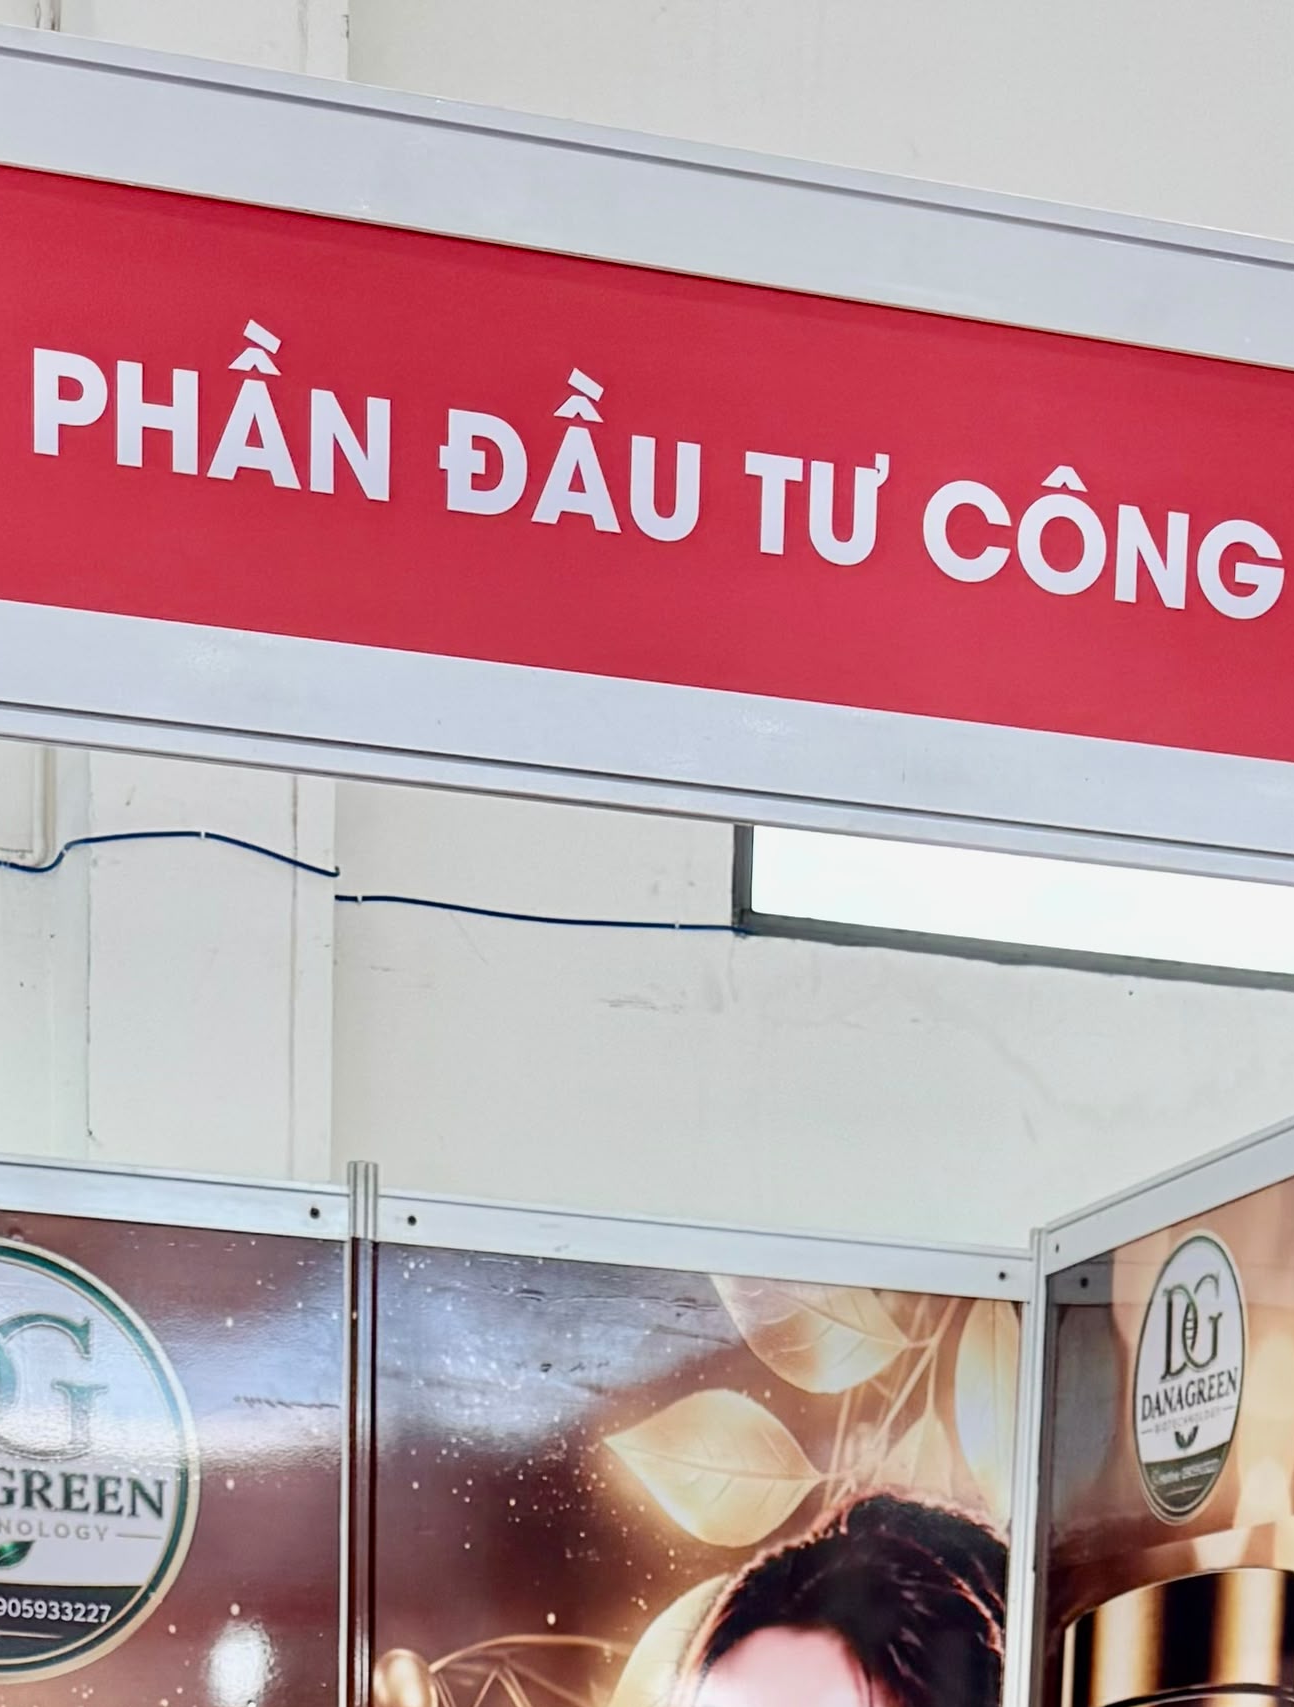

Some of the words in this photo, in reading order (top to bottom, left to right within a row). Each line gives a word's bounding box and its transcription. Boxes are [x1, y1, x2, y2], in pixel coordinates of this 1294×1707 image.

[33, 319, 391, 502] PHẦN
[438, 367, 702, 542] ĐẦU
[744, 450, 890, 566] TƯ
[922, 465, 1285, 620] CÔNG
[1140, 1366, 1238, 1423] DANAGREEN
